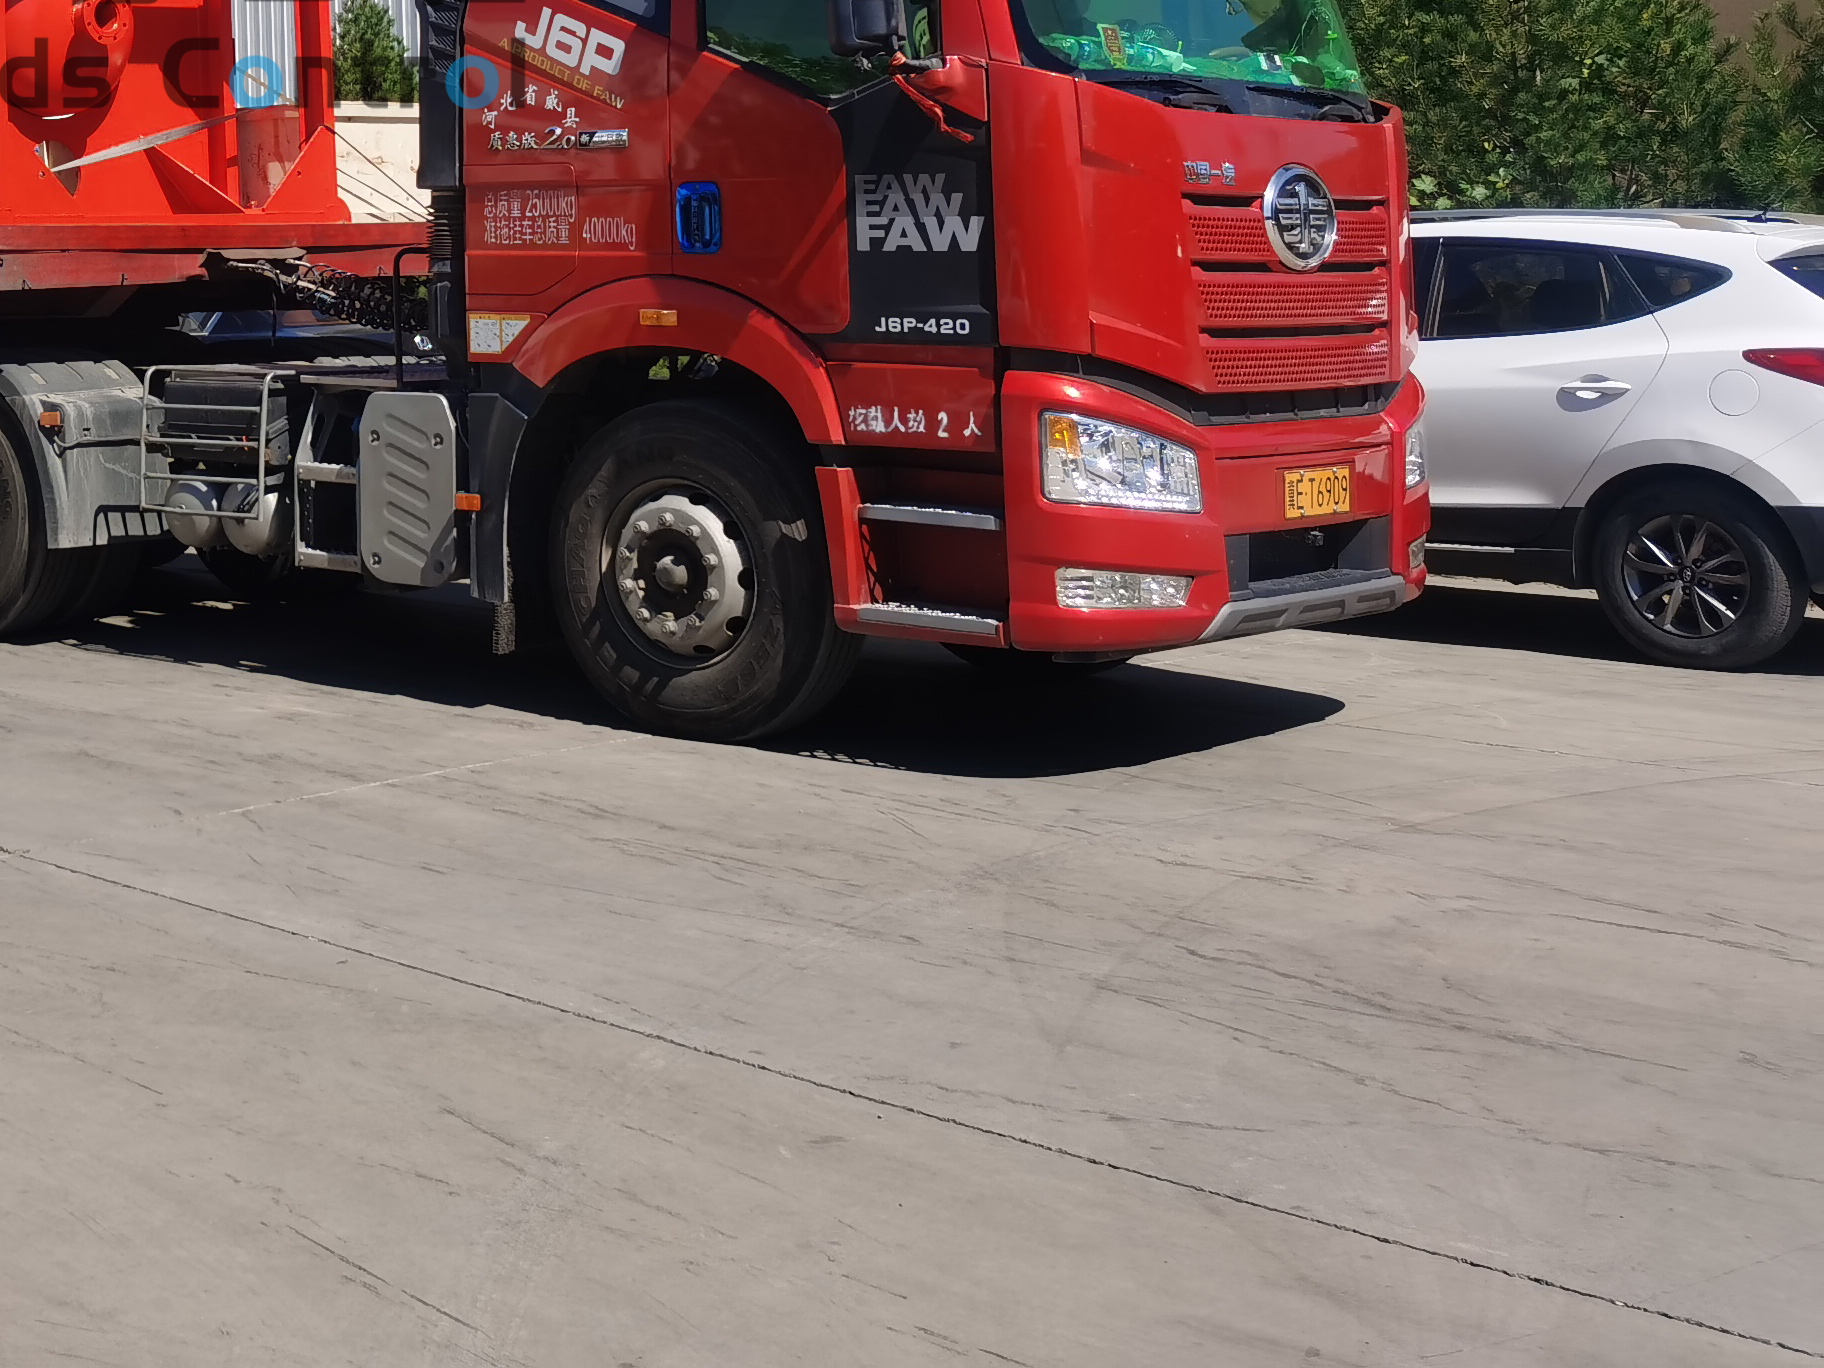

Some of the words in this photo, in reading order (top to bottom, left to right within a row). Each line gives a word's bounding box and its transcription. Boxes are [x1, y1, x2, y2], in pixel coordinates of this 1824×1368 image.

[514, 6, 626, 76] J6P
[512, 43, 571, 81] PRODUCT
[573, 76, 591, 91] OF
[593, 86, 626, 110] FAW
[482, 84, 580, 129] 河北省威县
[484, 189, 522, 217] 总质量
[525, 190, 576, 222] 25000kg
[484, 217, 570, 244] 准拖挂车总质量
[582, 217, 636, 250] 40000kg
[856, 216, 985, 252] FAW
[875, 317, 970, 334] J6P-420
[937, 411, 950, 438] 2
[963, 411, 982, 437] 人
